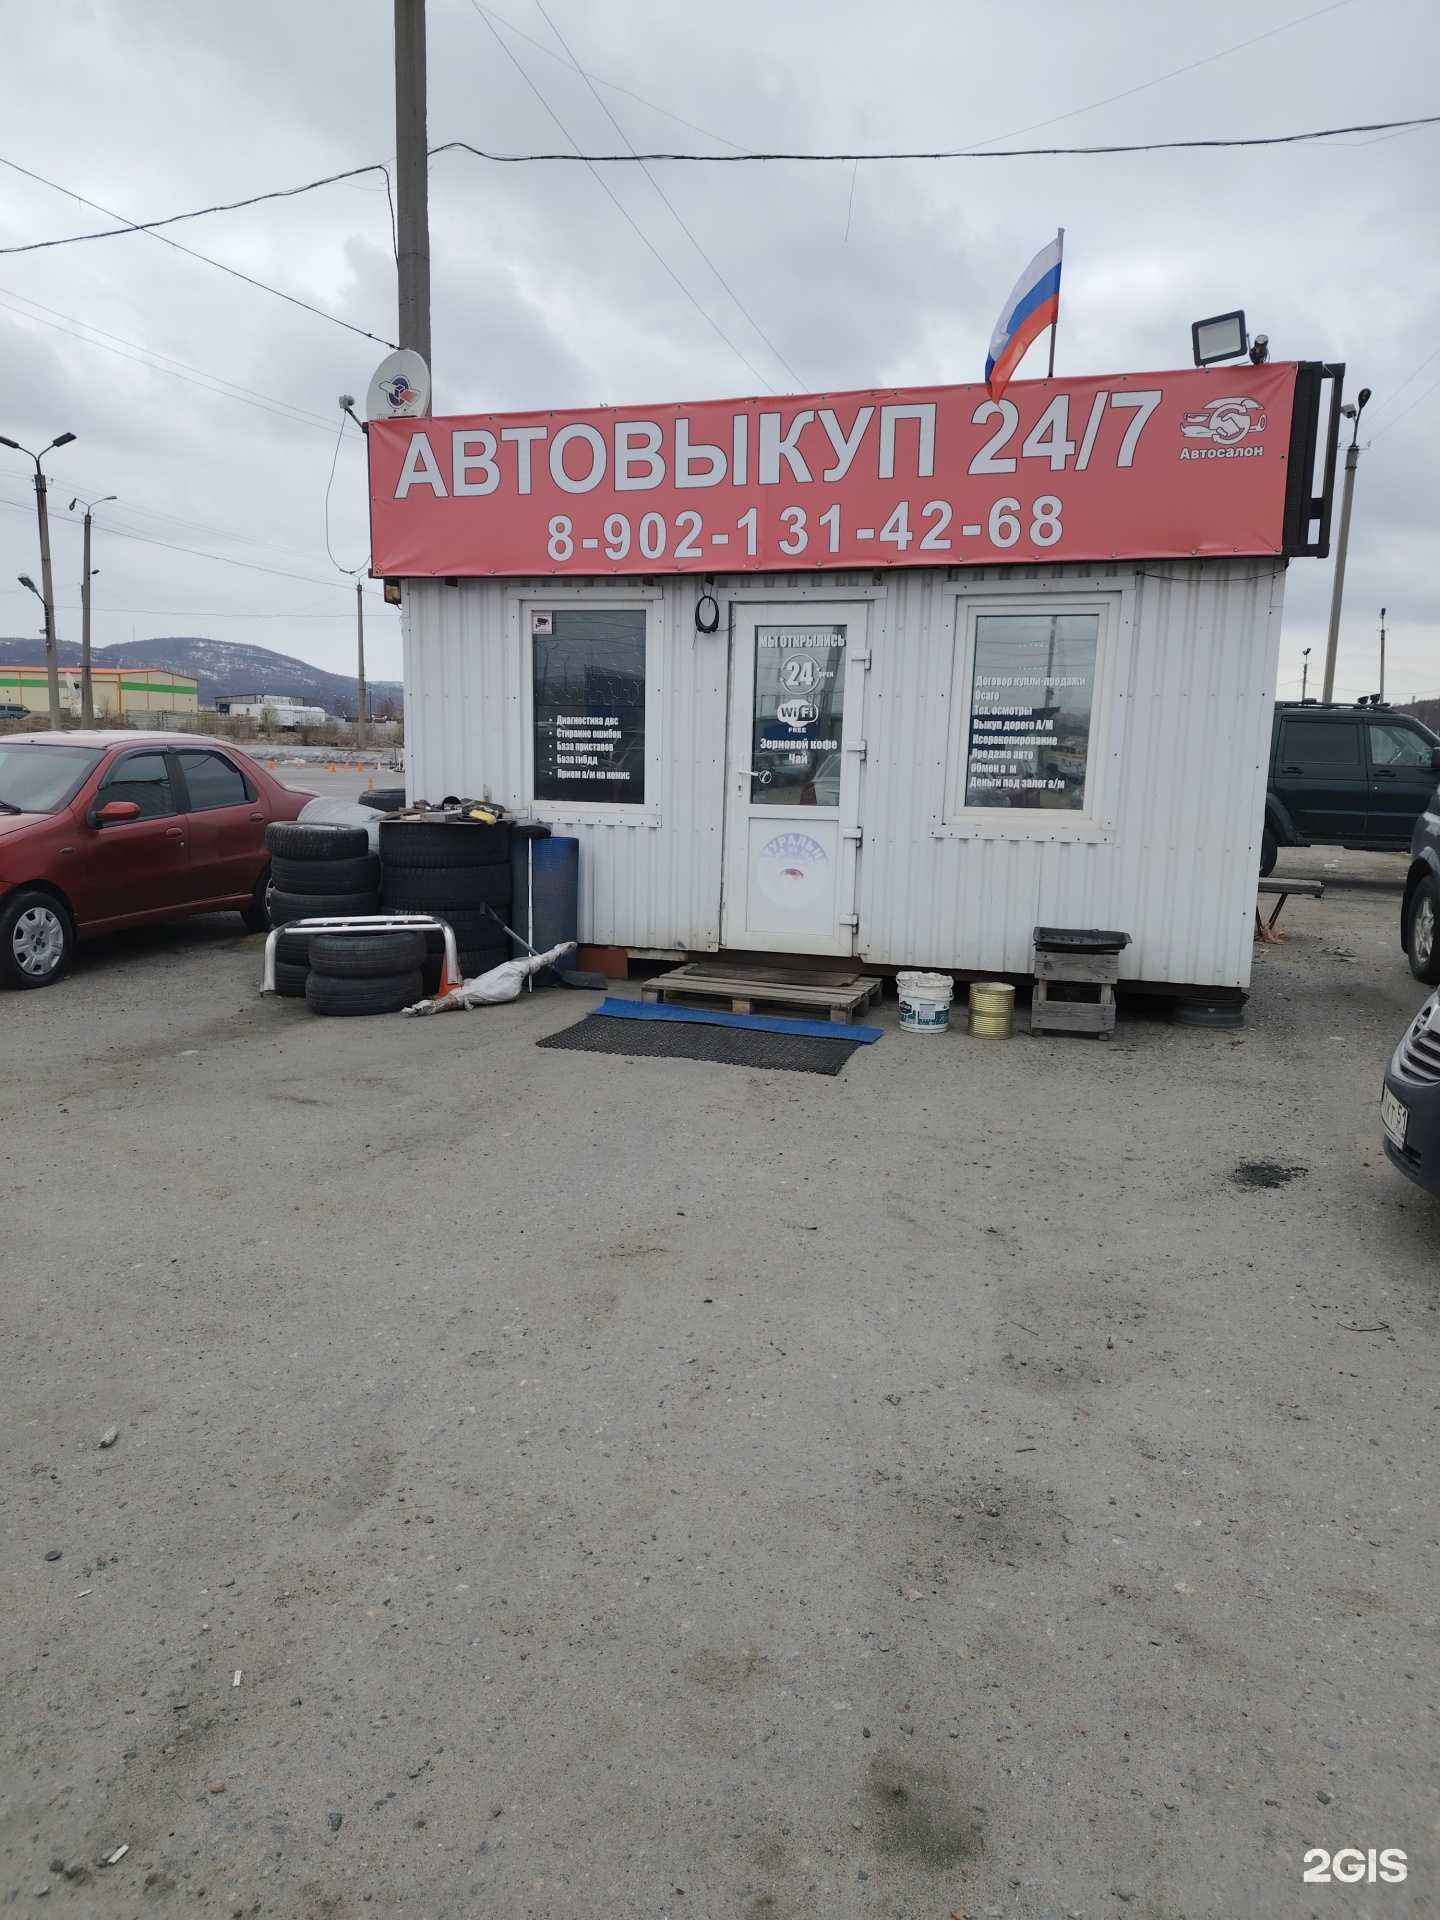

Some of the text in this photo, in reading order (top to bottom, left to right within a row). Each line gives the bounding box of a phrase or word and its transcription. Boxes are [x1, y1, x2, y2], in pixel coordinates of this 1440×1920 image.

[392, 390, 1163, 499] АВТОВЫКУП 24/7
[1180, 446, 1264, 460] Автосалон
[547, 495, 1063, 561] 8-902-131-42-68
[785, 661, 814, 686] 24
[760, 738, 838, 751] Зерновой кофе
[788, 751, 808, 765] Чай
